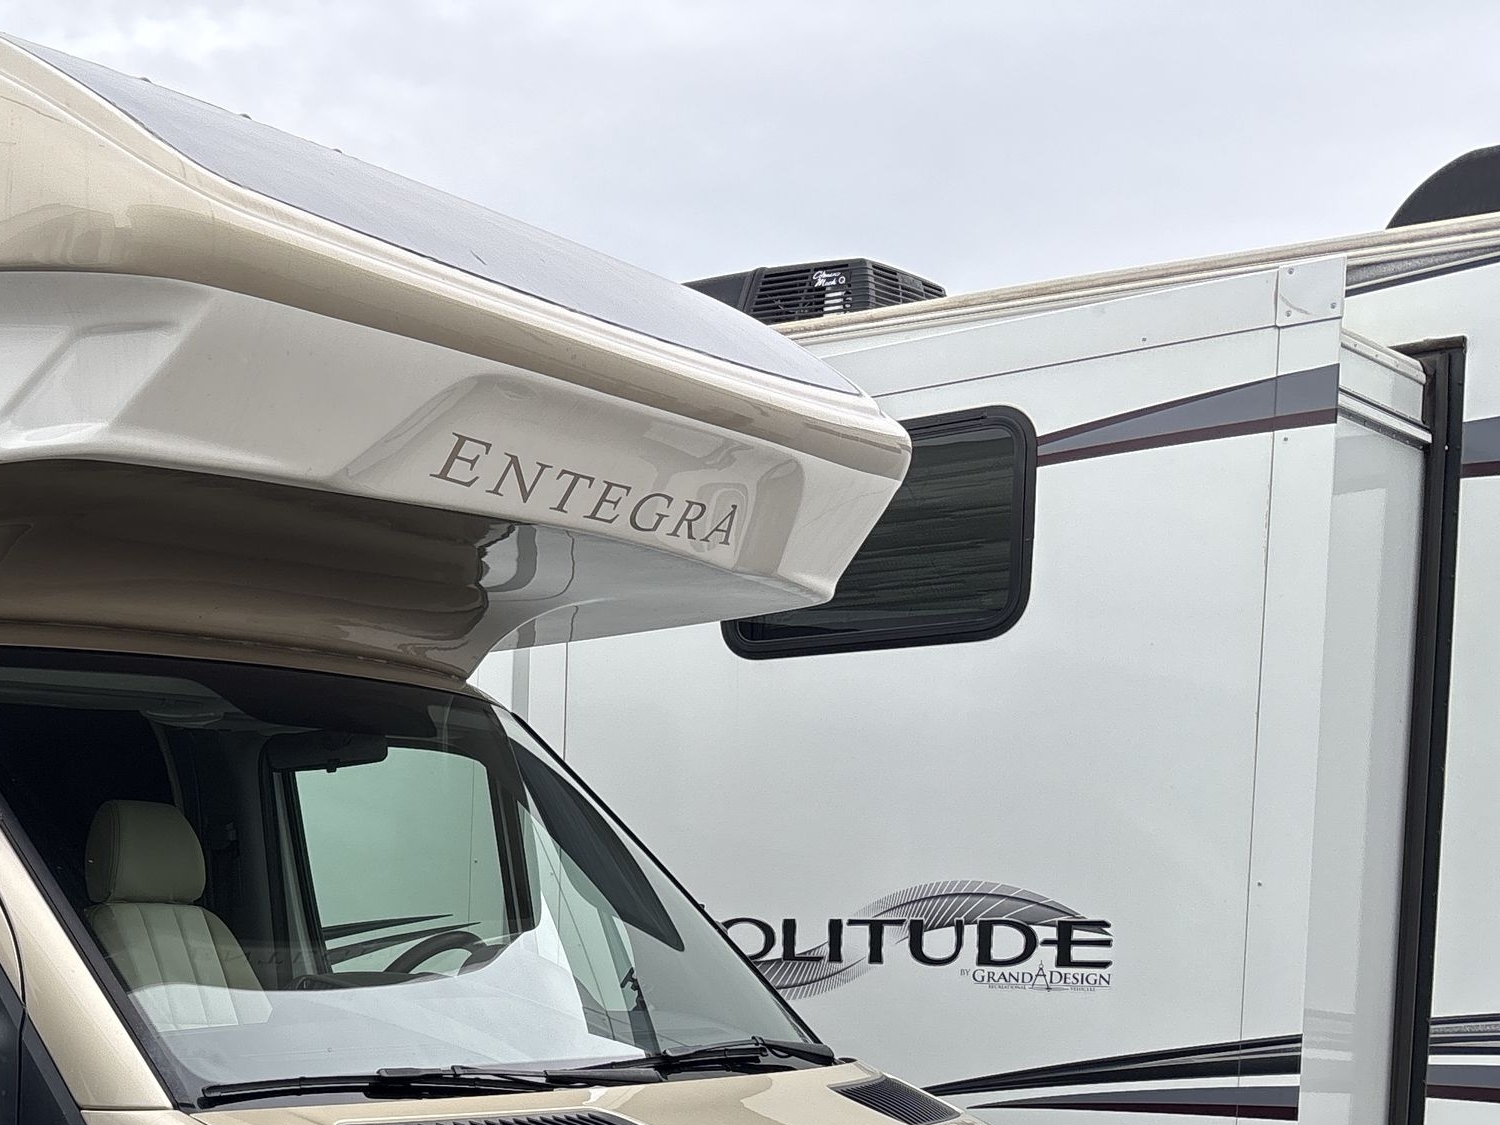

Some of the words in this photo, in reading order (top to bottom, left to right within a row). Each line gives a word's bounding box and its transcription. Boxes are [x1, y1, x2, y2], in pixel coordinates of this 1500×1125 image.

[428, 431, 738, 547] ENTEGRA
[960, 968, 971, 977] BY
[972, 969, 1034, 984] GRAND
[1049, 970, 1113, 986] DESIGN
